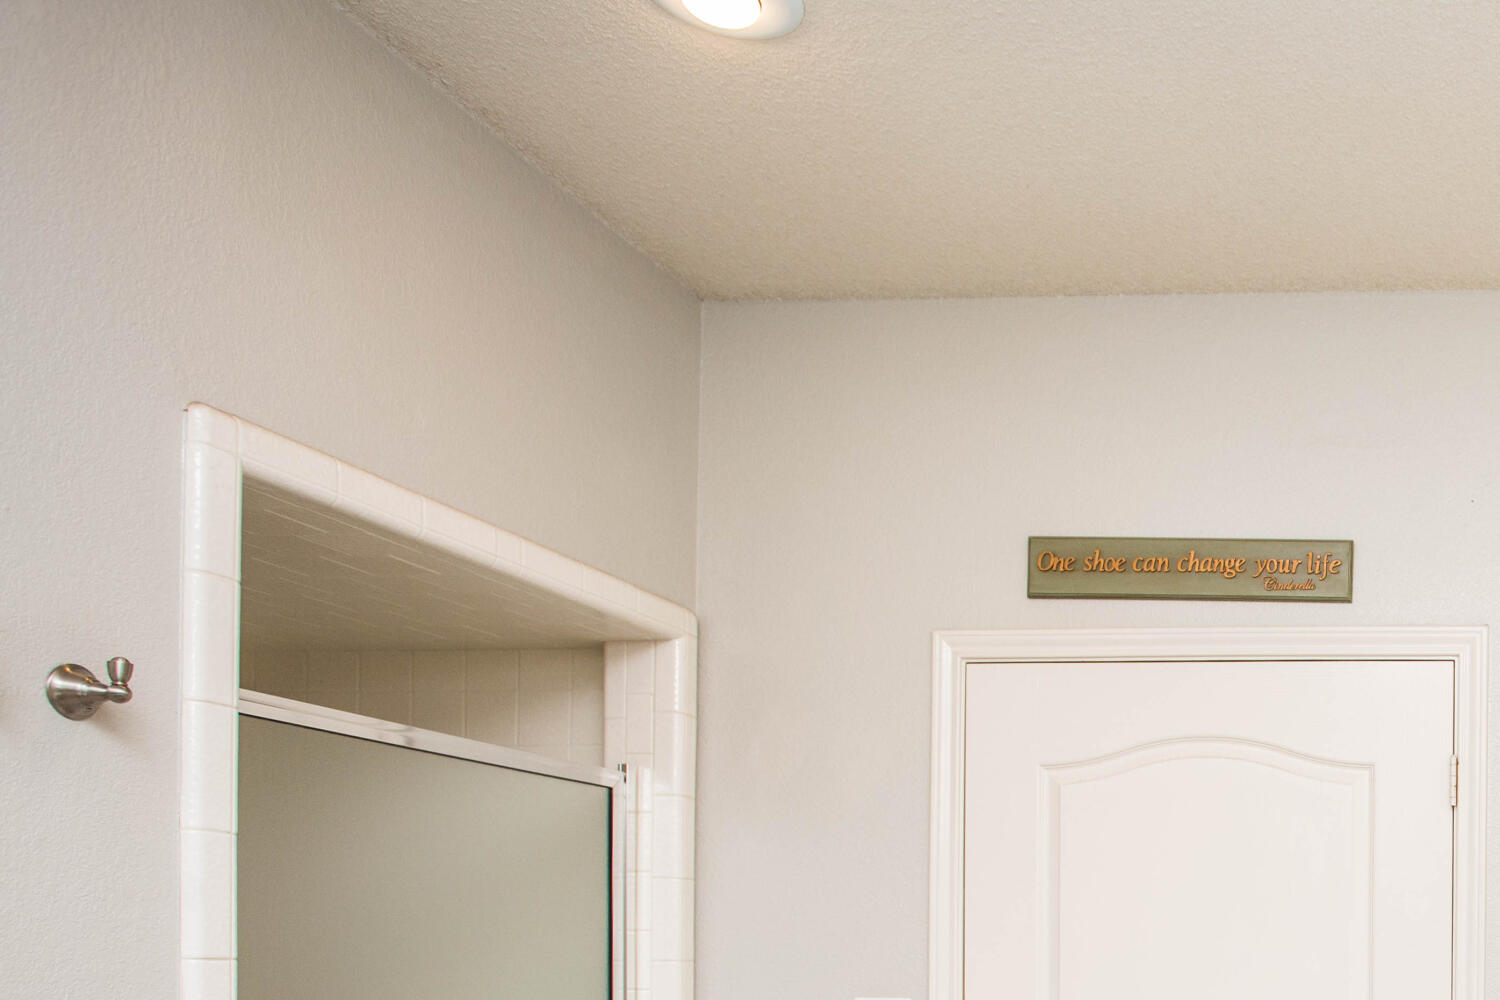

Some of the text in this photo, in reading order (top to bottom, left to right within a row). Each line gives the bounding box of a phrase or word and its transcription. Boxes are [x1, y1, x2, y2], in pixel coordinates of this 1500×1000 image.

[1037, 550, 1342, 581] One shoe can change your life
[1262, 576, 1316, 592] Cinderella
